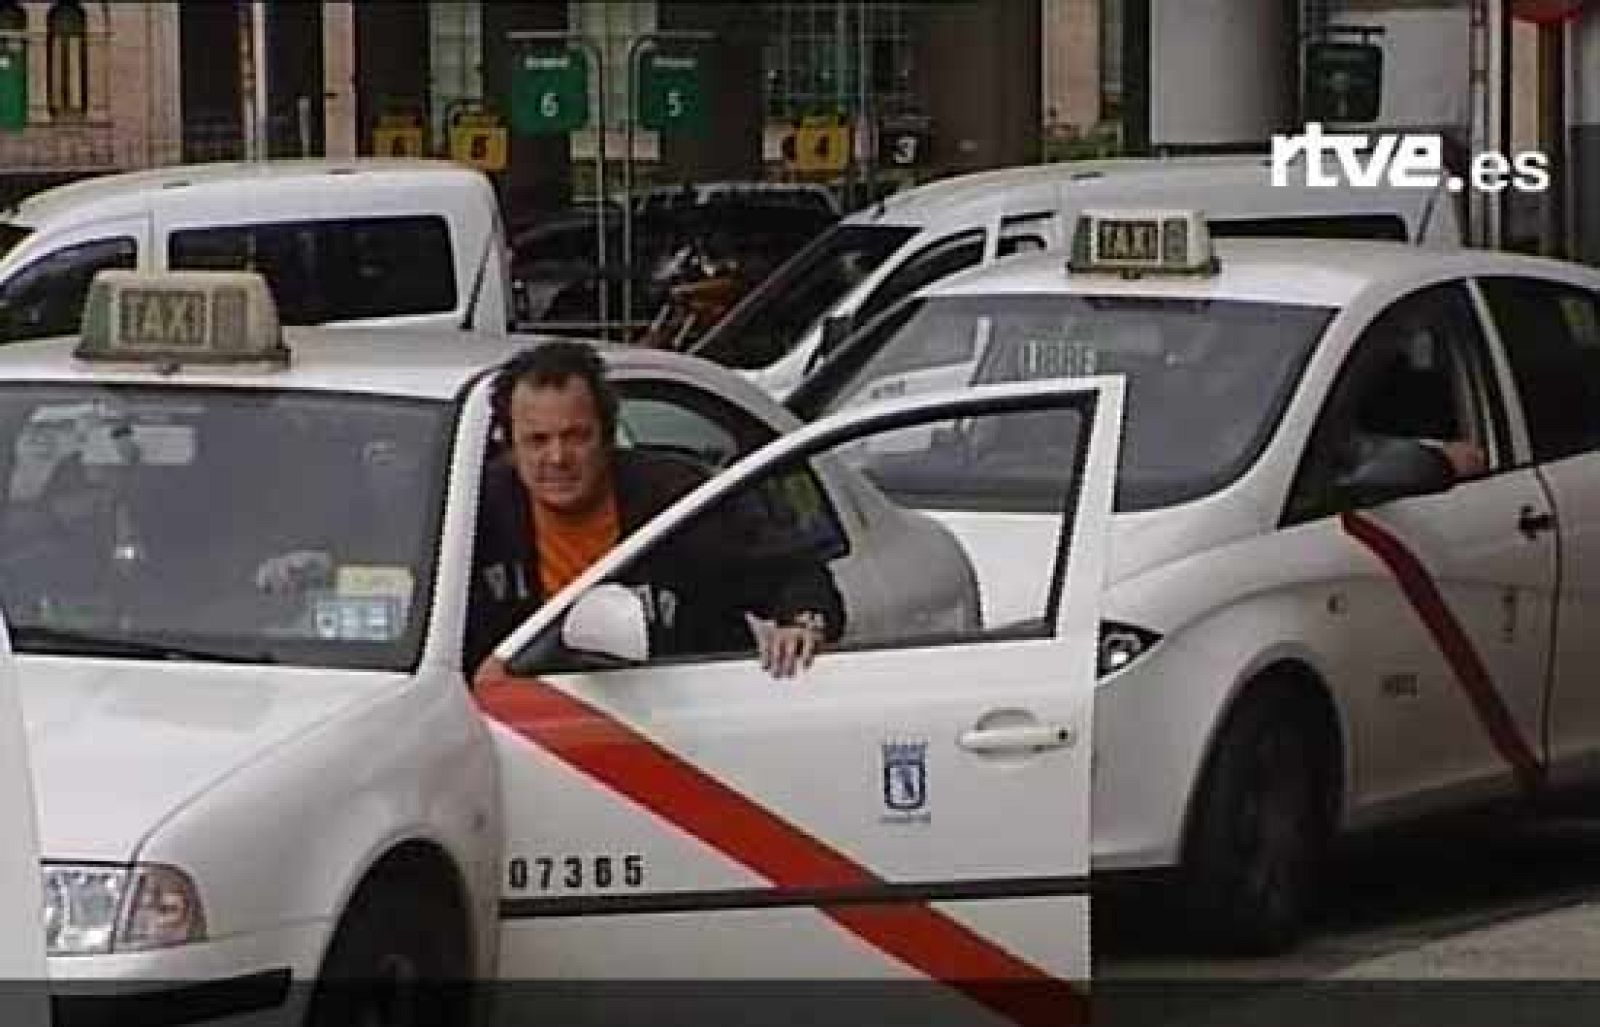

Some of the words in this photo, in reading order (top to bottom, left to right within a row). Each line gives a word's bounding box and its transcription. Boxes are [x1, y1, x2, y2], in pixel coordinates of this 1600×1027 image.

[541, 92, 560, 118] 6
[667, 90, 683, 118] 5
[893, 136, 917, 164] 3
[1100, 224, 1158, 256] TAXI
[124, 293, 204, 340] TAXI
[509, 855, 644, 890] 07365
